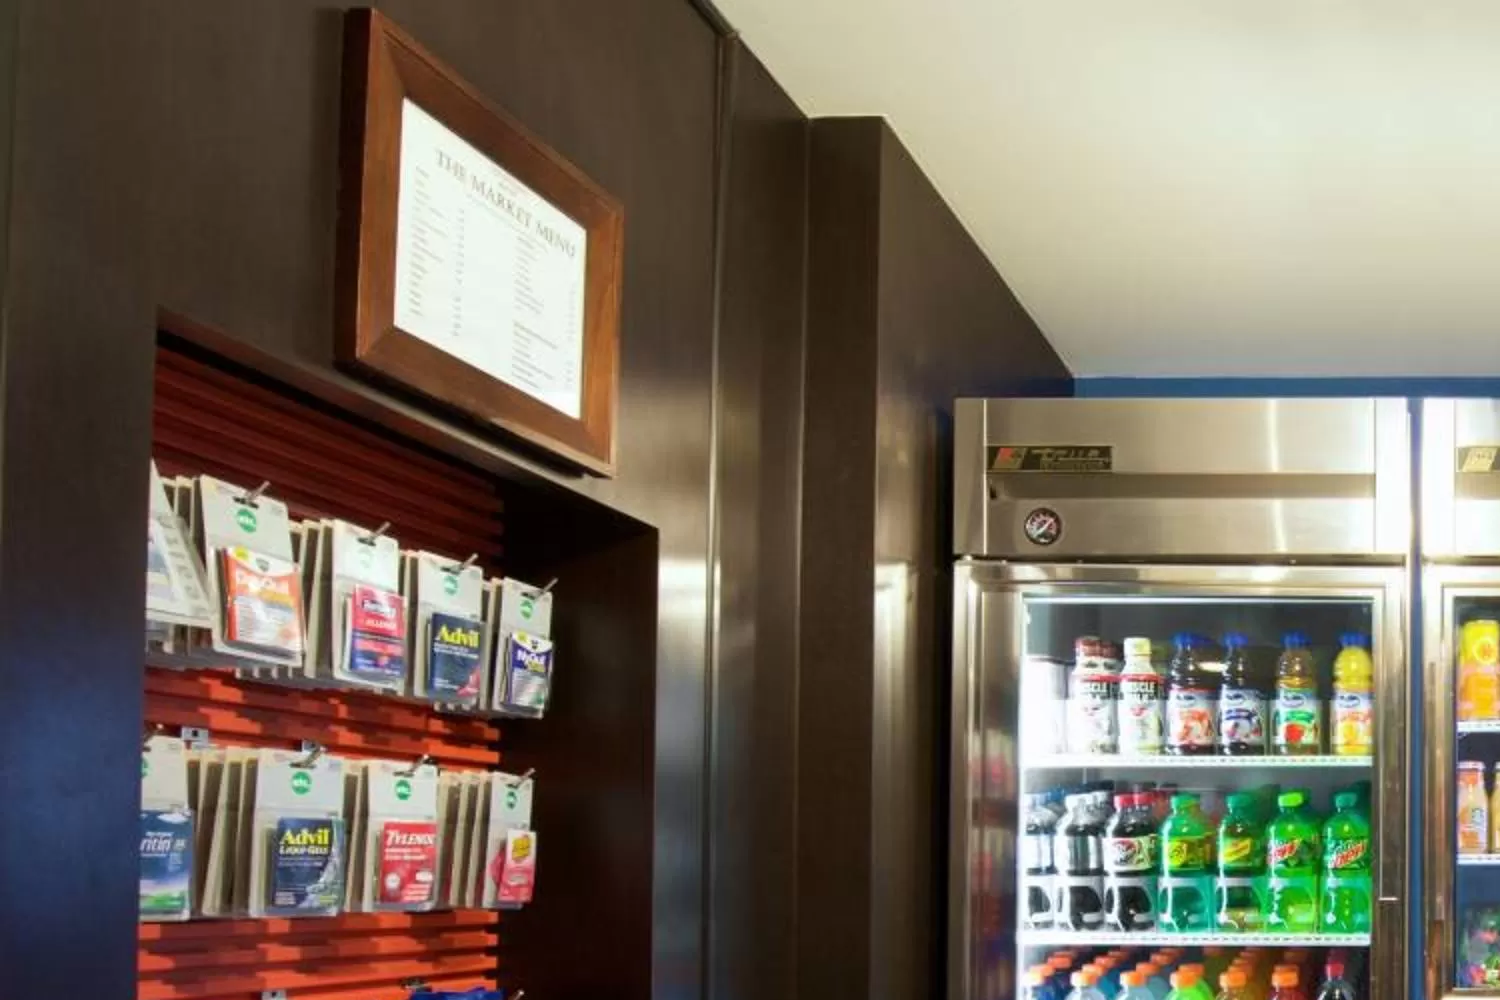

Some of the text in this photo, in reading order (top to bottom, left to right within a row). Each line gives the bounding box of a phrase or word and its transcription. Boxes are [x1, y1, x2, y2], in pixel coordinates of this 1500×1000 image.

[435, 149, 576, 258] THE MARKET MENU
[437, 622, 481, 649] Advil
[280, 827, 330, 846] Advil
